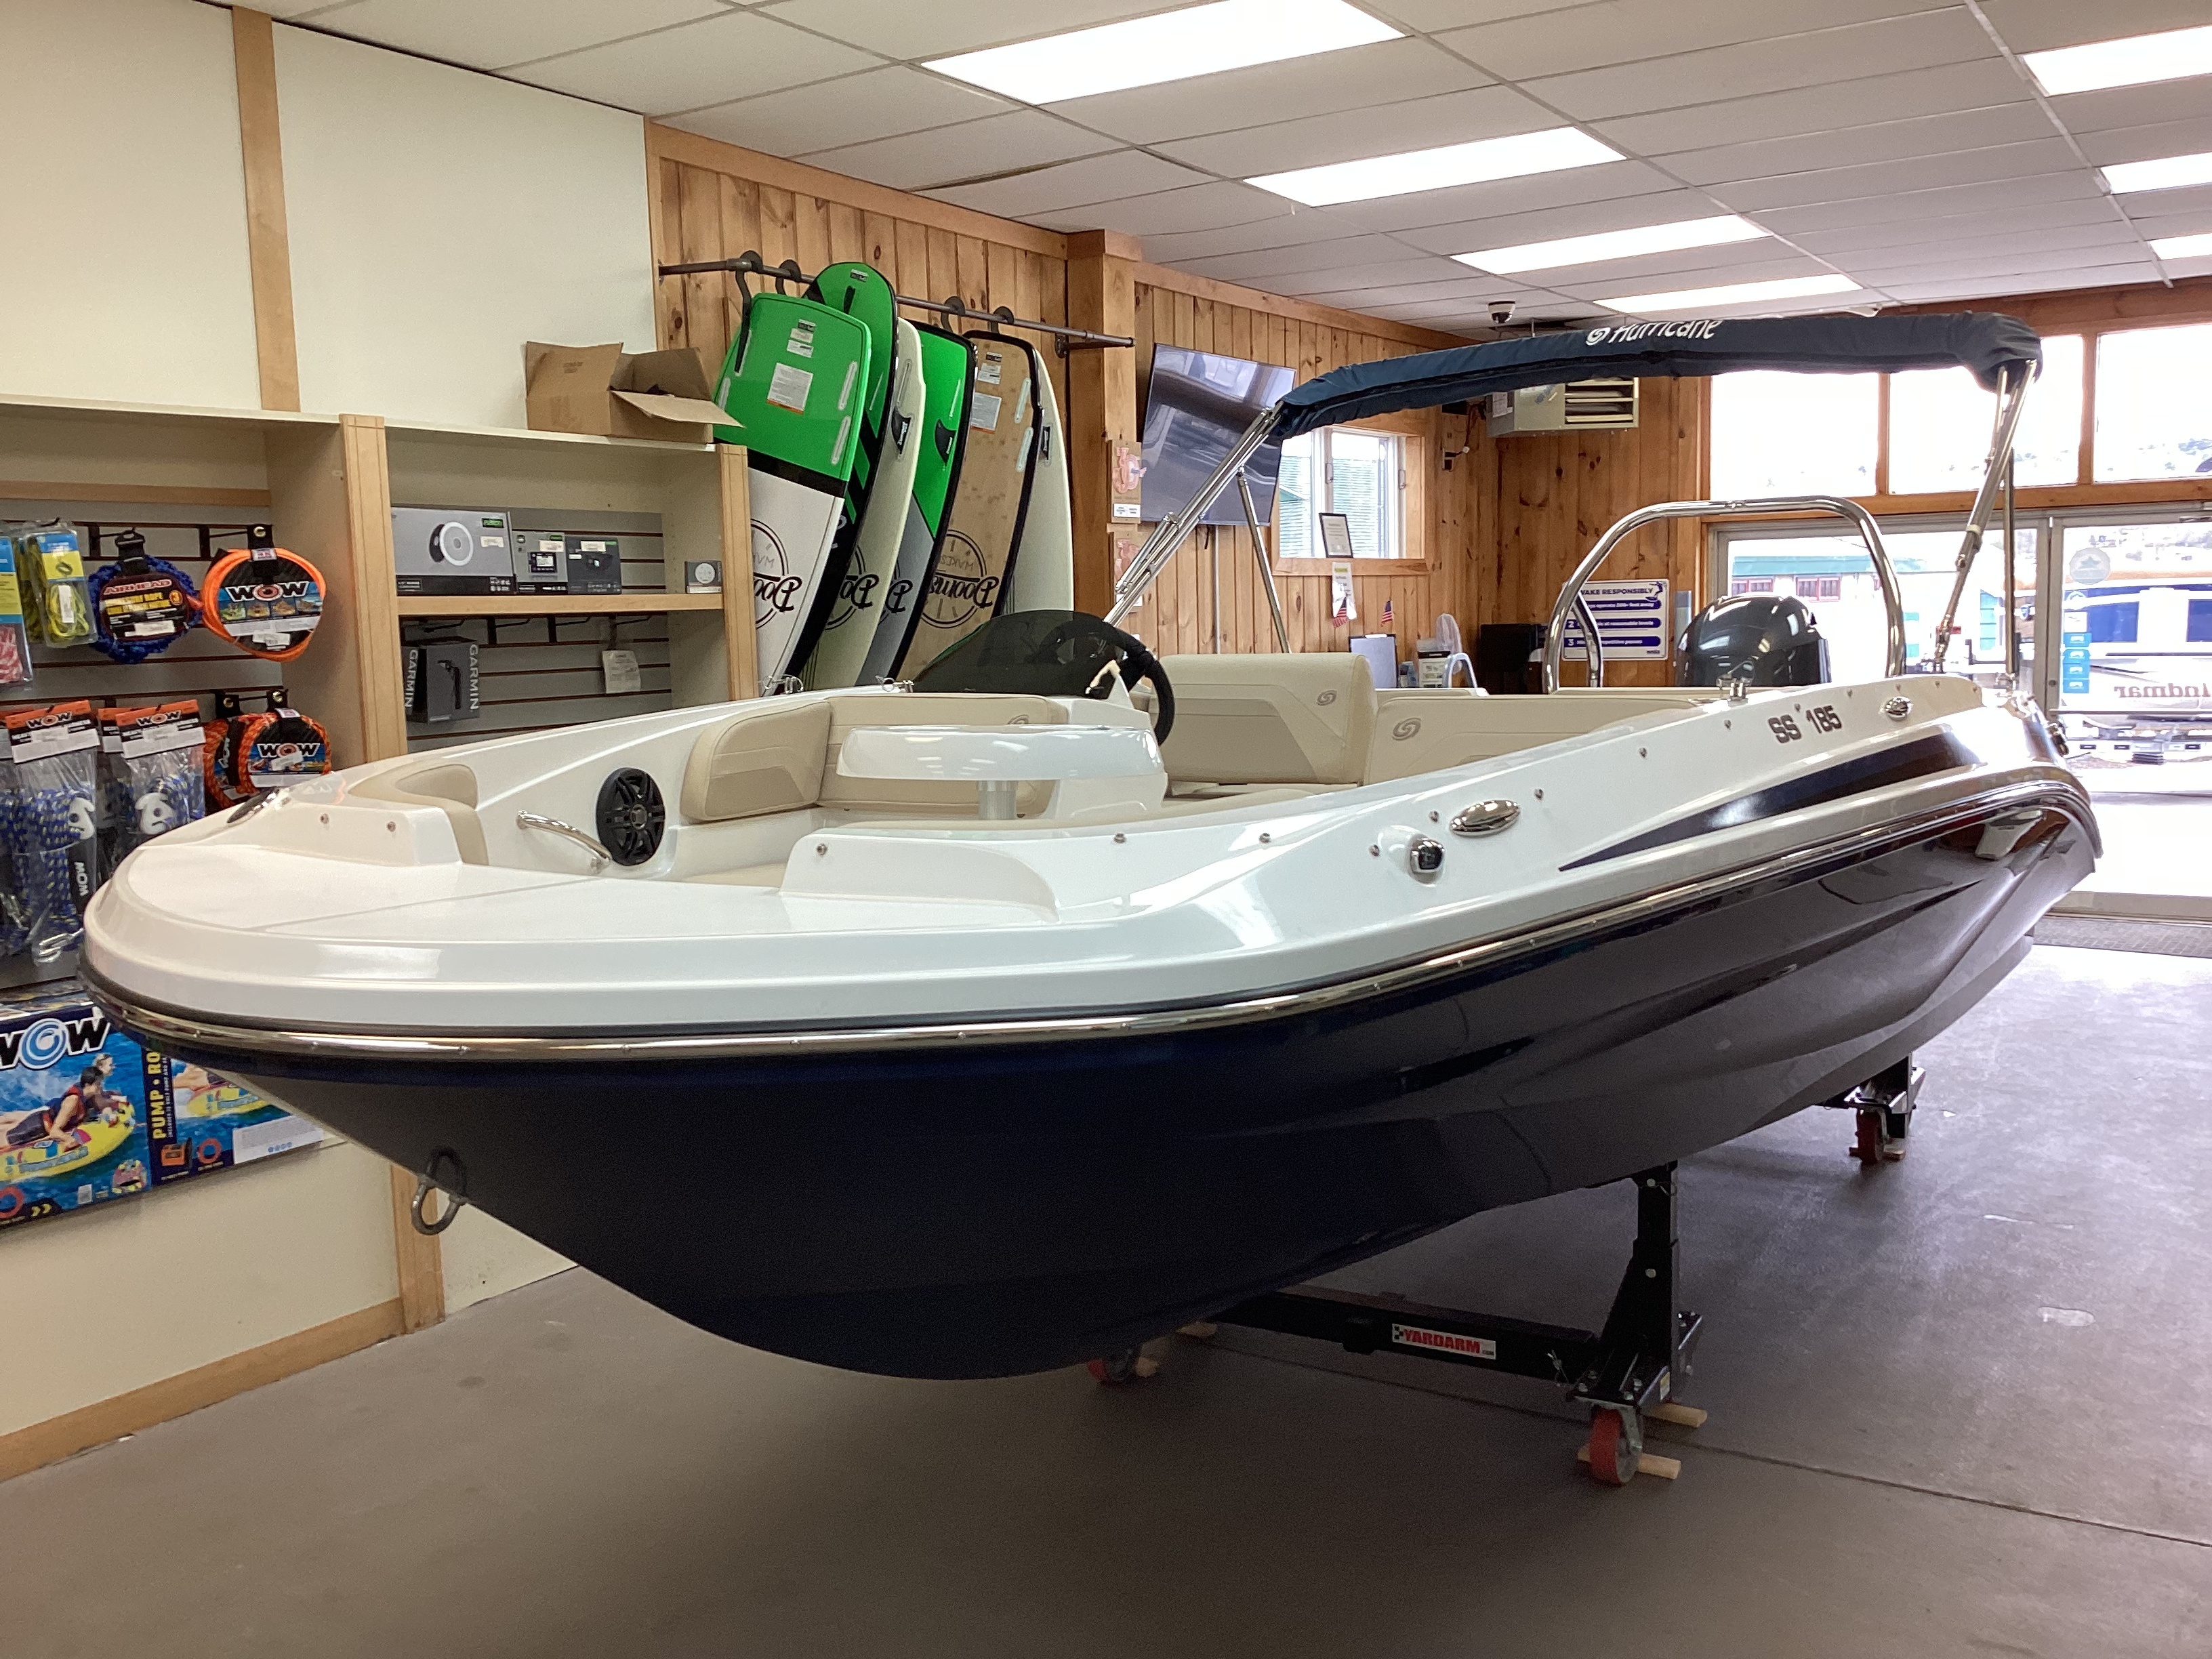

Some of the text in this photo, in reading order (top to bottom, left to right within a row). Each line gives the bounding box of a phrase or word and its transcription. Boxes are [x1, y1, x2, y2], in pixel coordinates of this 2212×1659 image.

[1608, 319, 1723, 343] Hurricane
[103, 579, 172, 595] AIRHEAD
[225, 581, 310, 602] WOW
[405, 649, 419, 708] GARMIN
[469, 644, 480, 710] GARMIN
[25, 711, 73, 729] WOW
[135, 710, 182, 726] WOW
[1768, 705, 1842, 743] SS 185
[256, 743, 321, 758] WOW
[149, 1090, 167, 1139] PUMP
[1404, 1329, 1481, 1353] YARDARM
